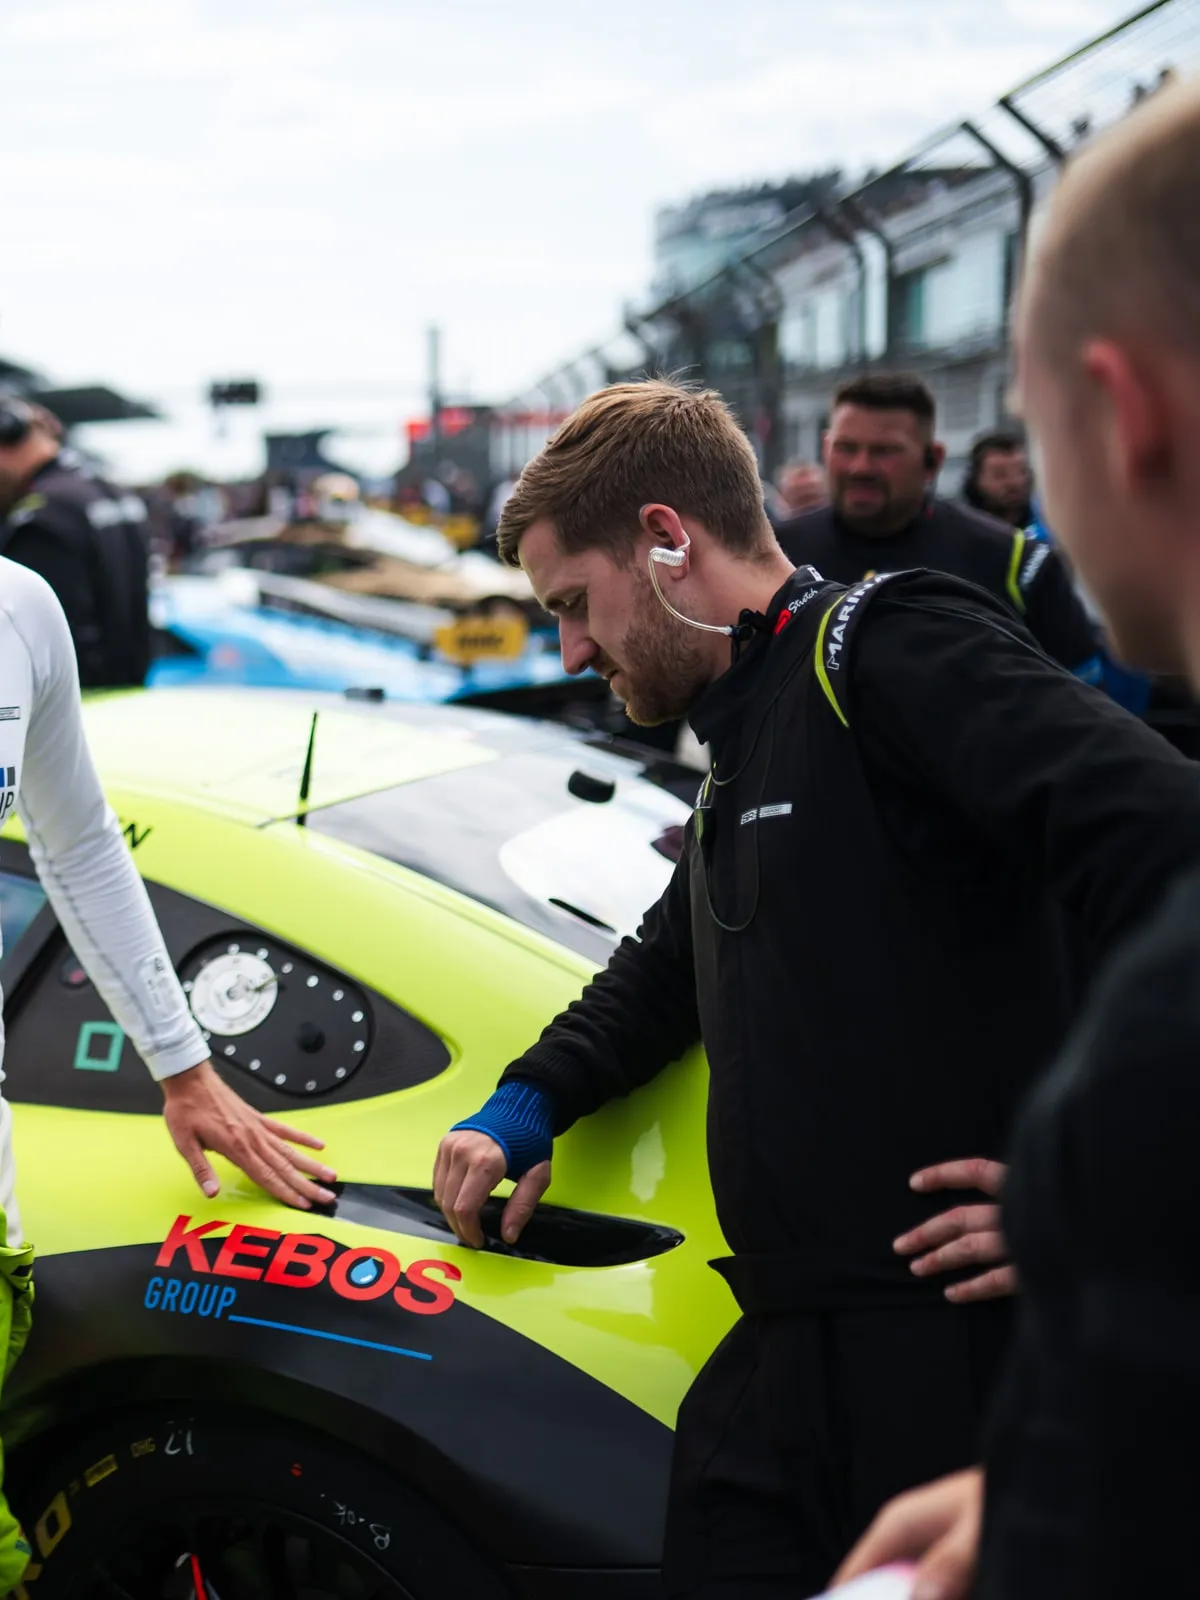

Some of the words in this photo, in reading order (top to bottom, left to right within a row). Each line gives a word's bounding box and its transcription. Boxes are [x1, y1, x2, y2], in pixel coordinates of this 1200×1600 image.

[788, 588, 818, 614] Stretch
[827, 574, 892, 670] MARIN
[144, 1277, 237, 1319] GROUP
[155, 1214, 462, 1315] KEBOS
